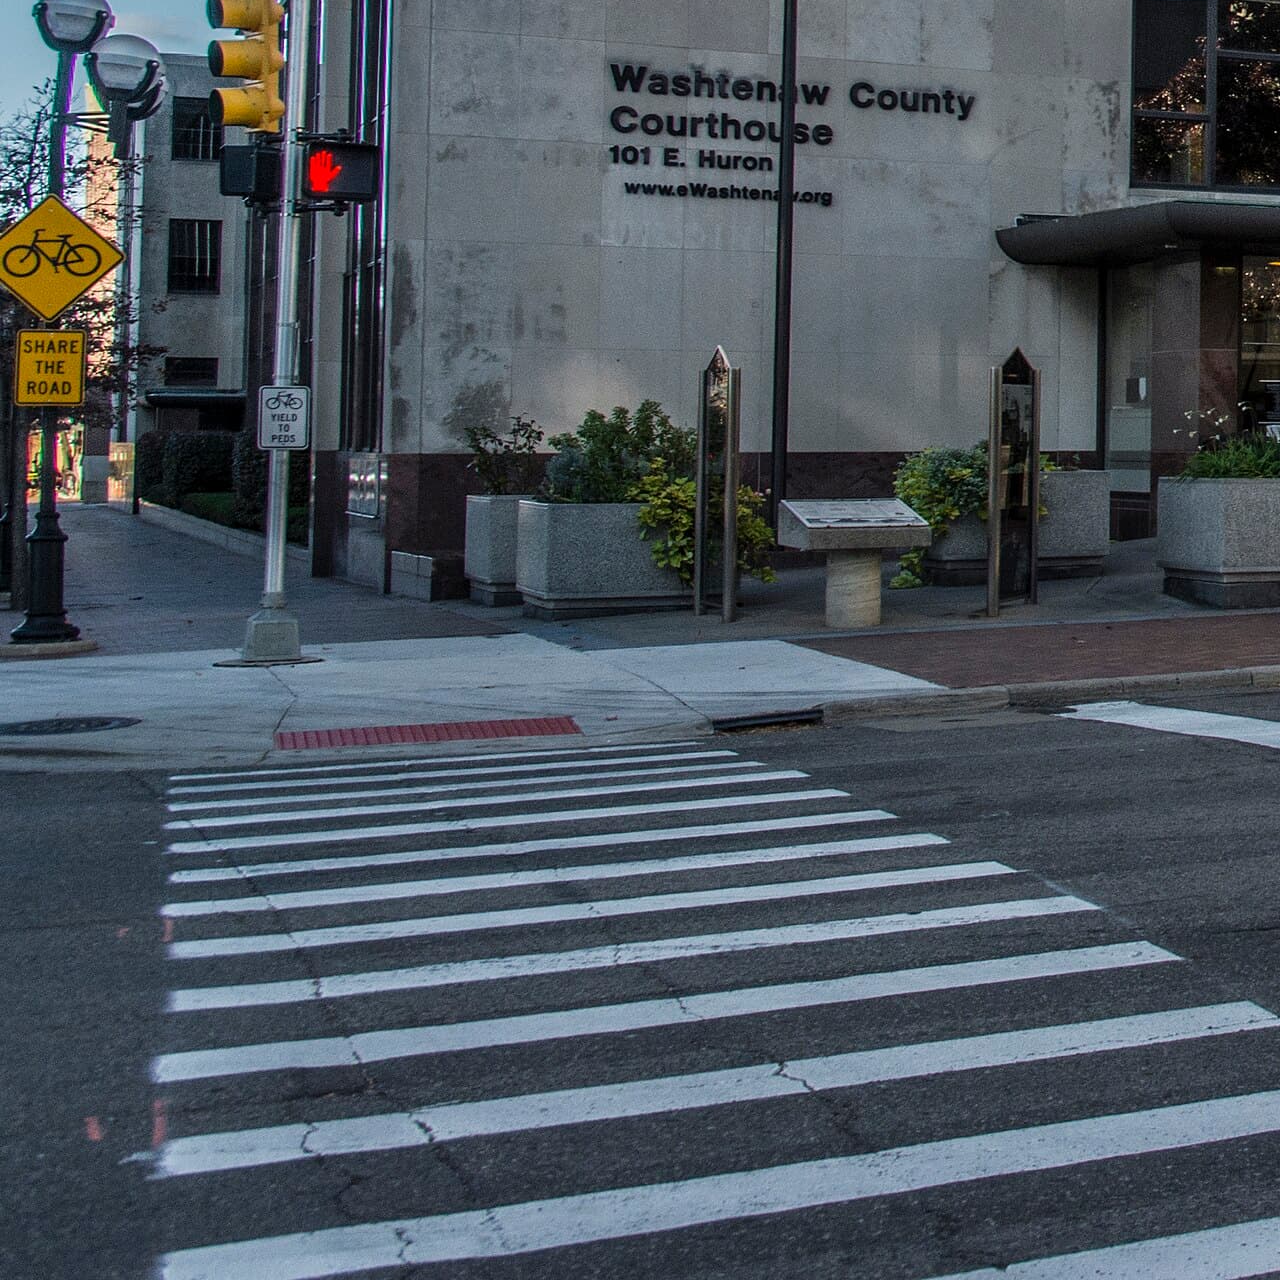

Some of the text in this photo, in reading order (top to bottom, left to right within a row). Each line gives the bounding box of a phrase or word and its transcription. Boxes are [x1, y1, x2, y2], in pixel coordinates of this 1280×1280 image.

[849, 82, 976, 121] County
[610, 105, 834, 146] Courthouse
[609, 144, 773, 172] 101 E. Huron
[23, 339, 79, 354] SHARE
[35, 360, 65, 375] THE
[27, 381, 72, 395] ROAD
[271, 413, 298, 422] YIELD
[278, 423, 290, 433] TO
[271, 434, 296, 443] PEDS
